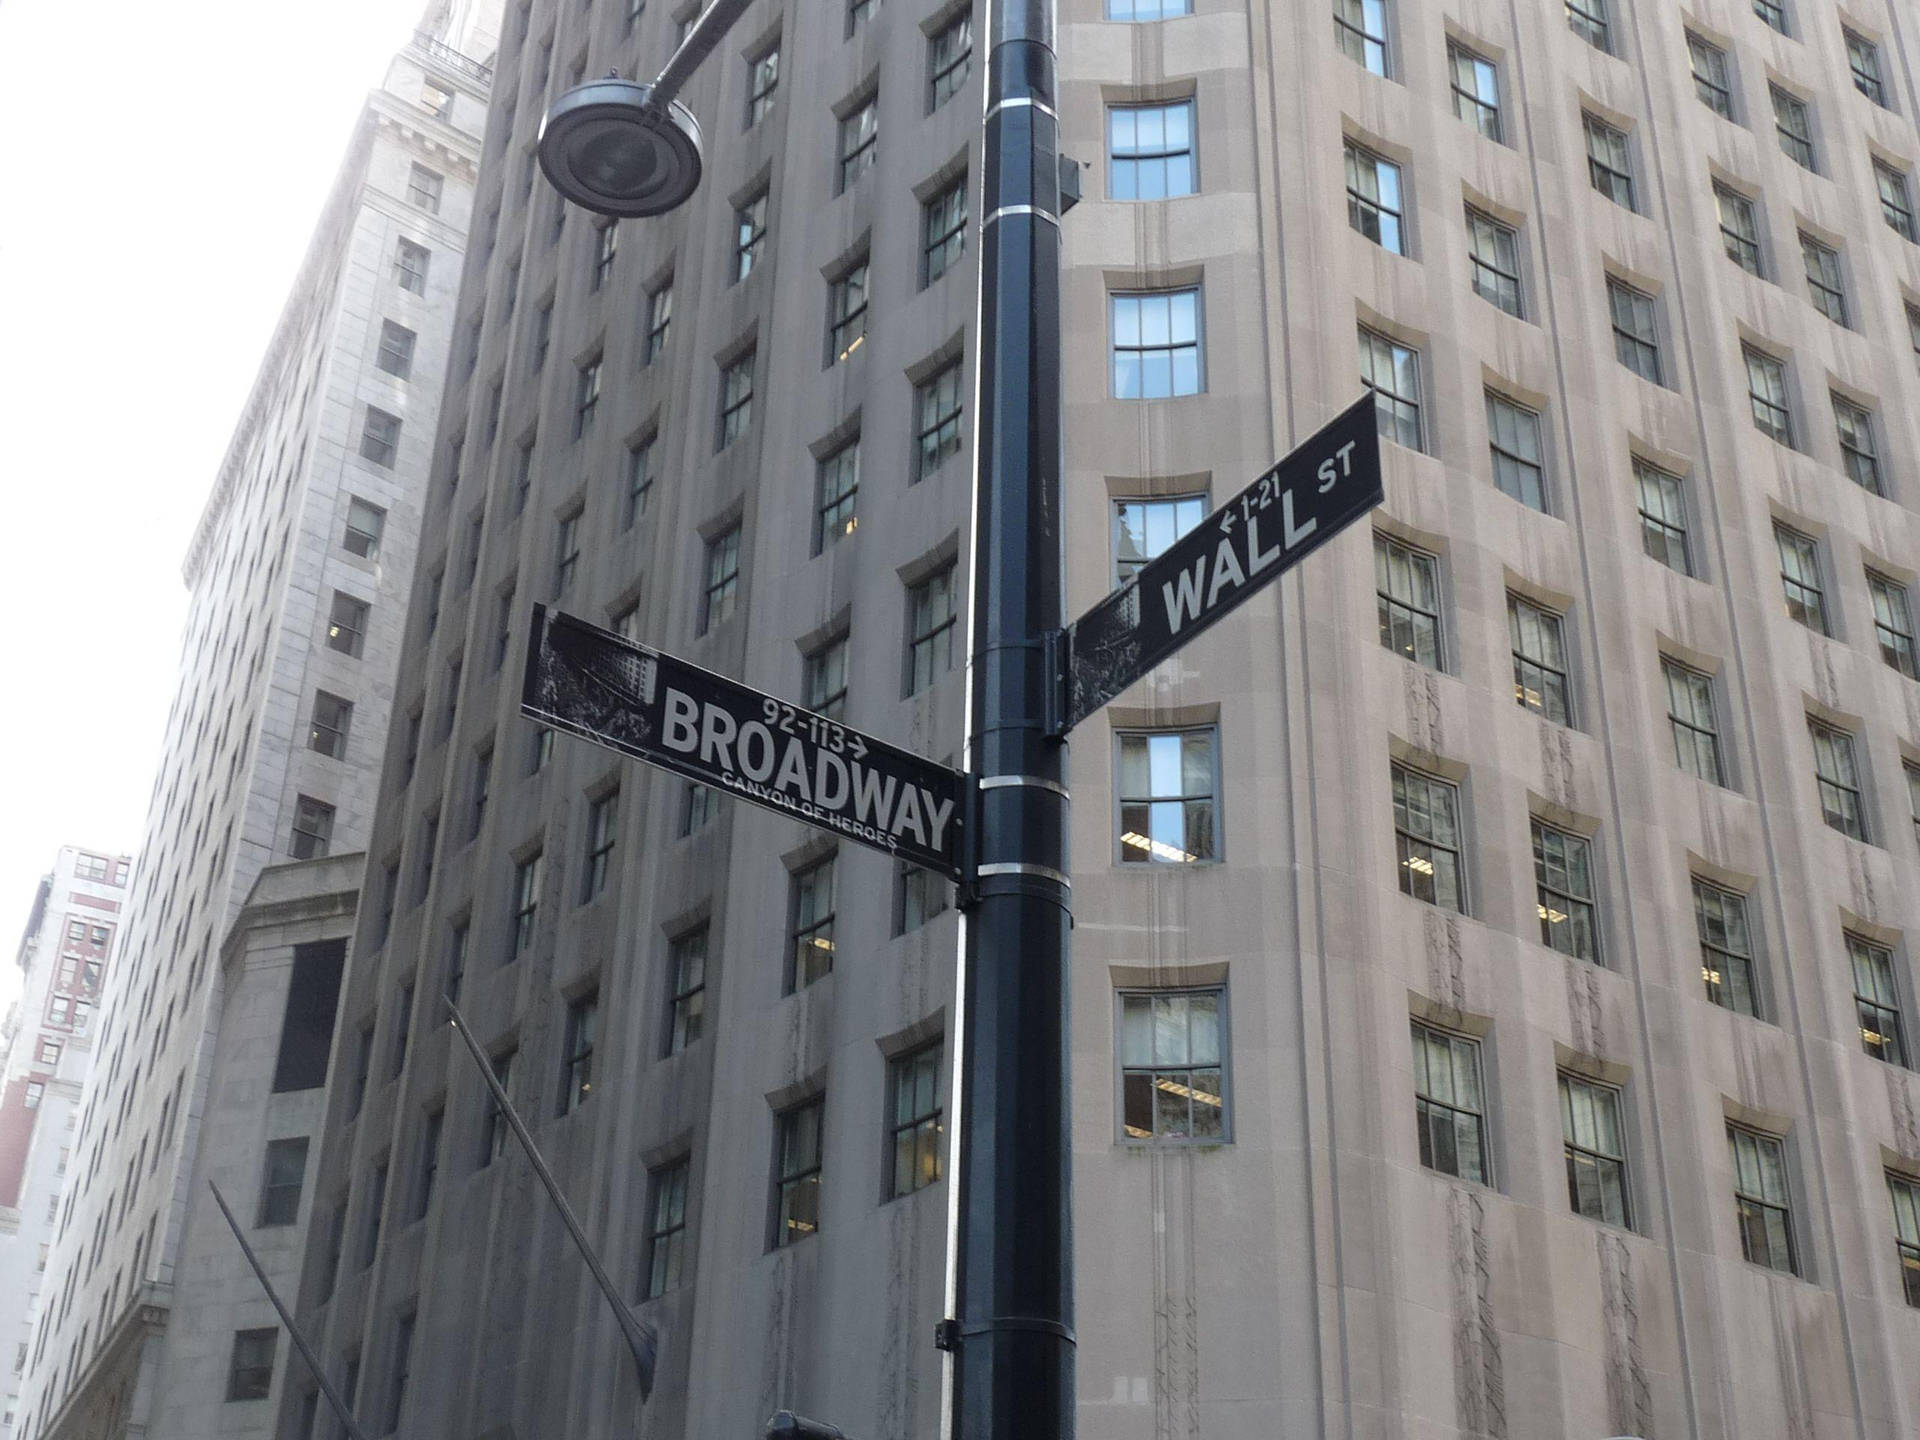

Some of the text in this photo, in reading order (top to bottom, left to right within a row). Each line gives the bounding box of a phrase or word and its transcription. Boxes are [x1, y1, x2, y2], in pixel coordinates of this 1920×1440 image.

[1241, 471, 1281, 521] 1-21
[1162, 440, 1356, 635] WALL ST
[763, 698, 845, 753] 92-113
[661, 686, 955, 852] BROADWAY
[722, 771, 898, 849] CANYON OF HEROES
